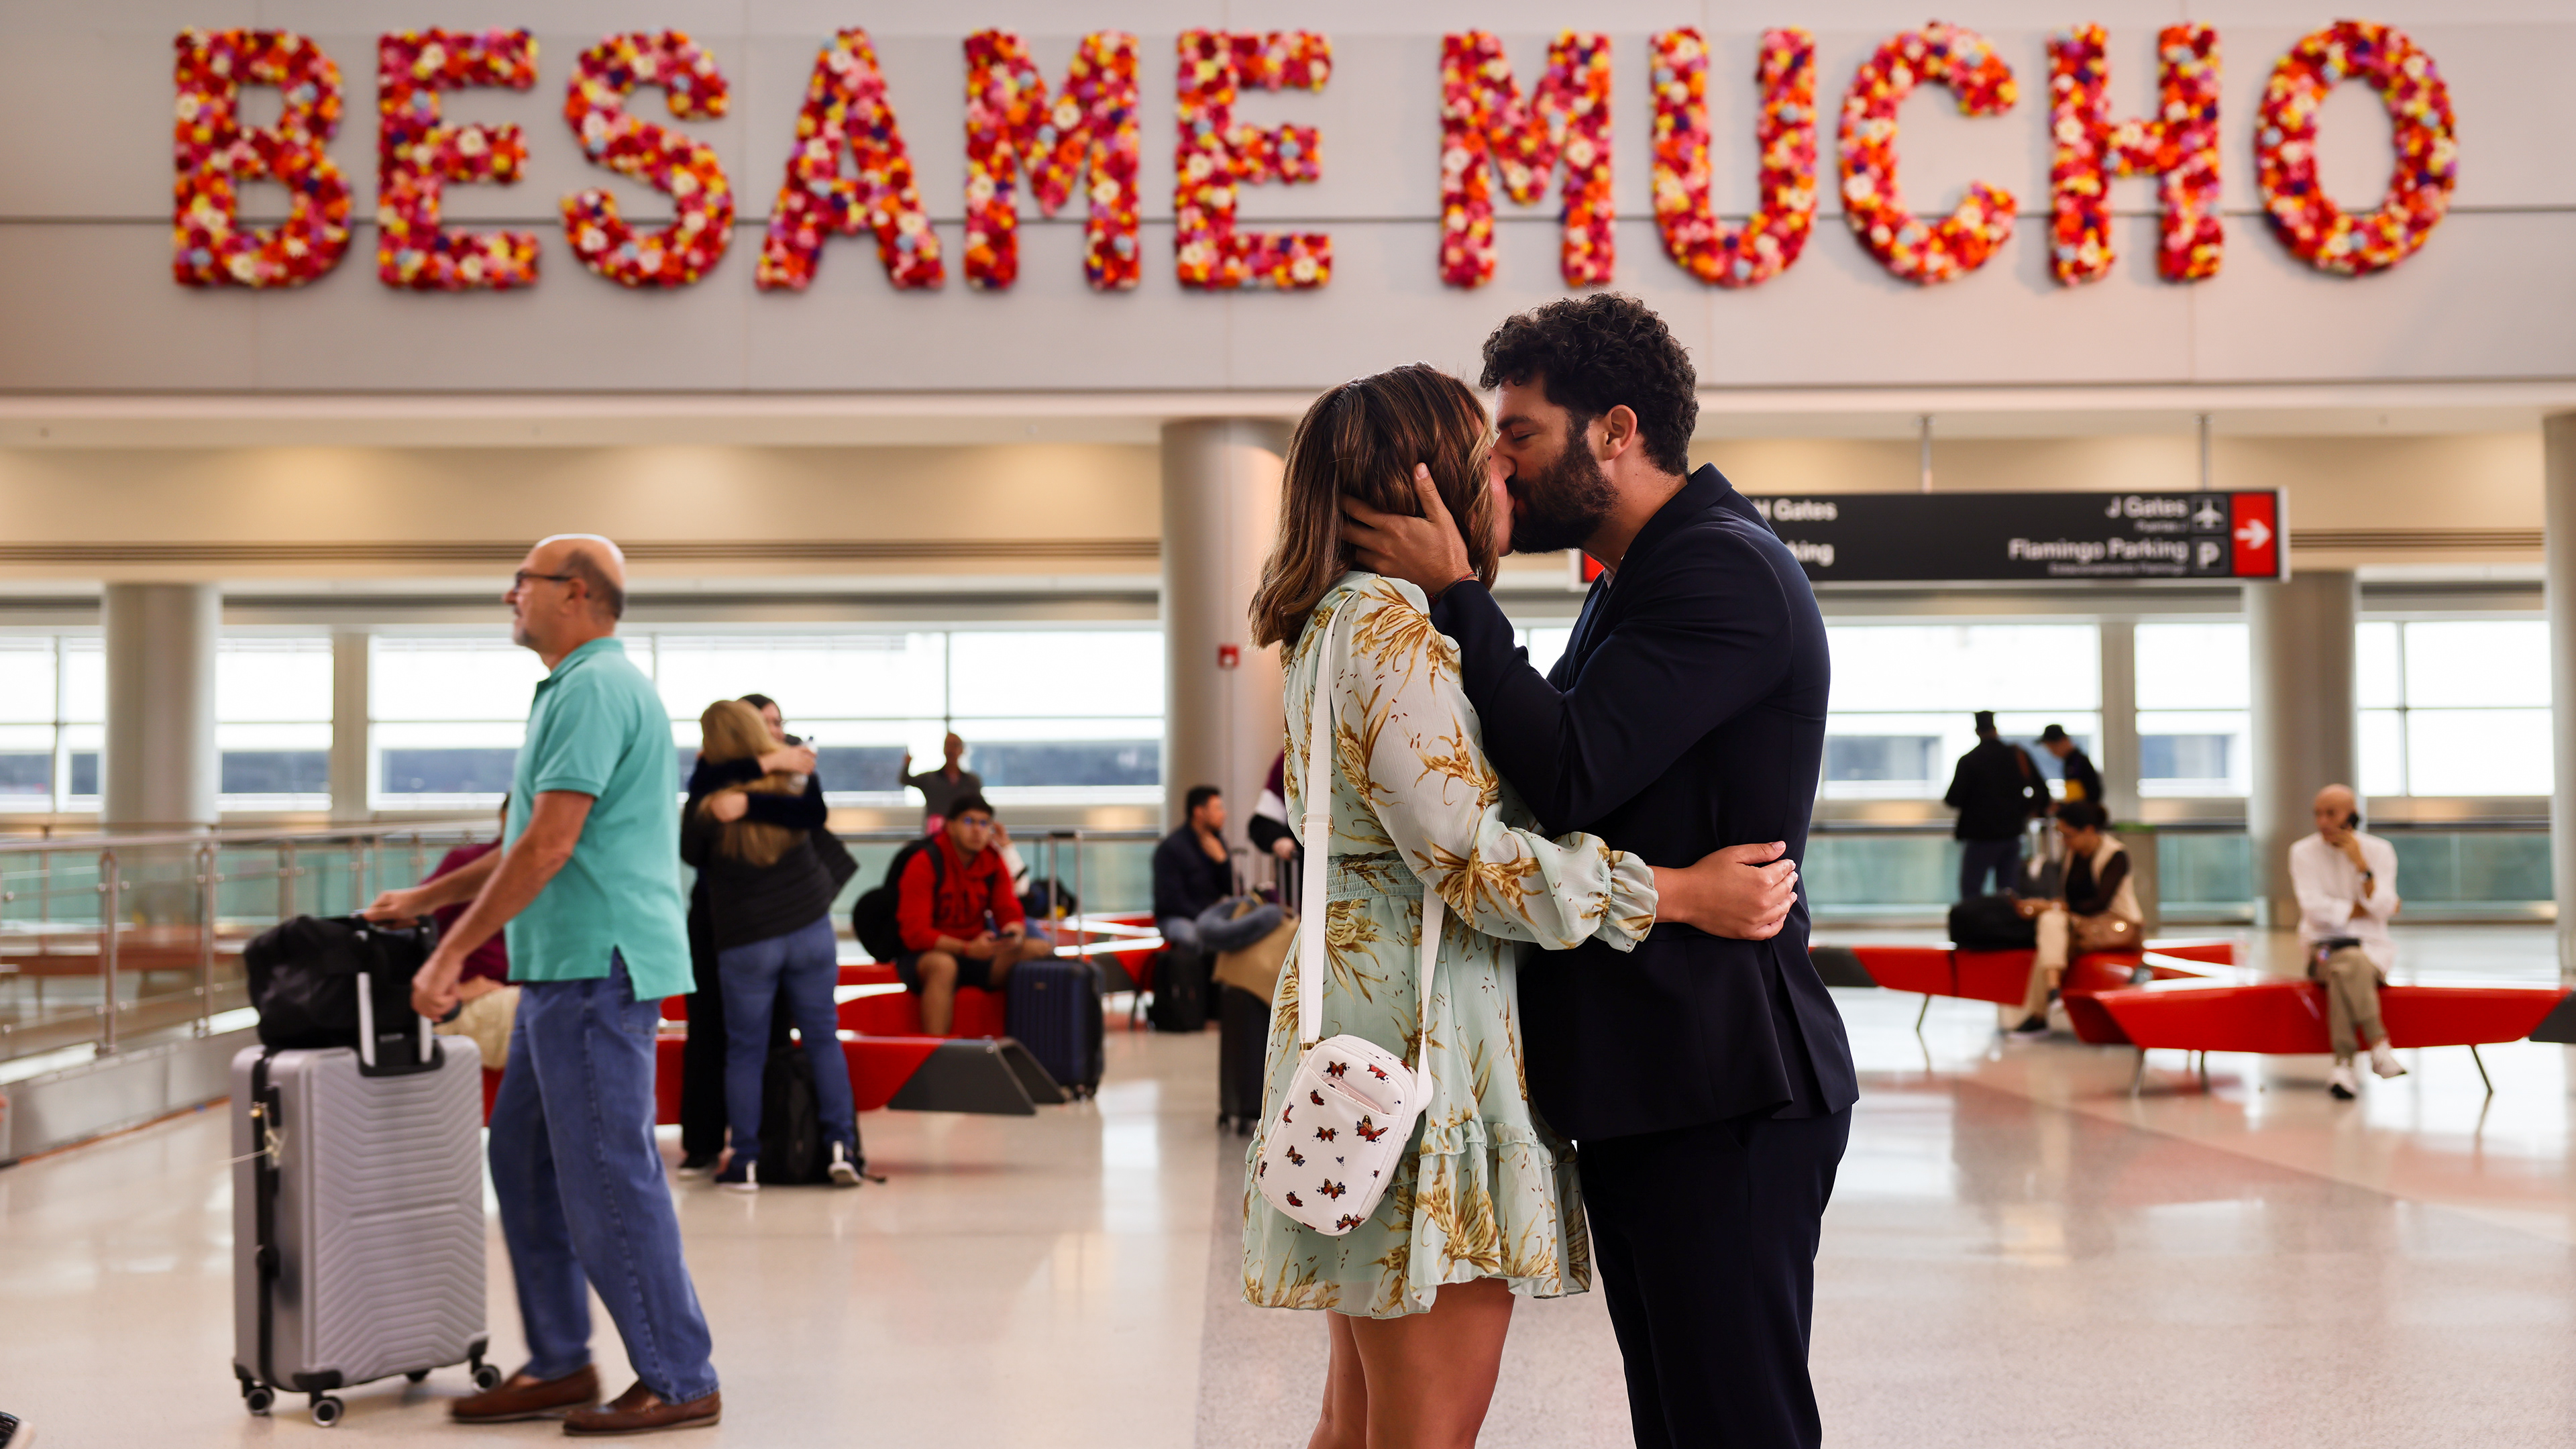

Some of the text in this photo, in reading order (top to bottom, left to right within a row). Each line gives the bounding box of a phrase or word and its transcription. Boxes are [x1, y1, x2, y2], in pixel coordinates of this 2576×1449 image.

[172, 21, 2458, 292] BESAME MUCHO
[1773, 498, 1838, 521] Gates
[2104, 495, 2189, 519] J Gates
[1784, 540, 1835, 567] king
[2008, 537, 2189, 565] Flamingo Parking
